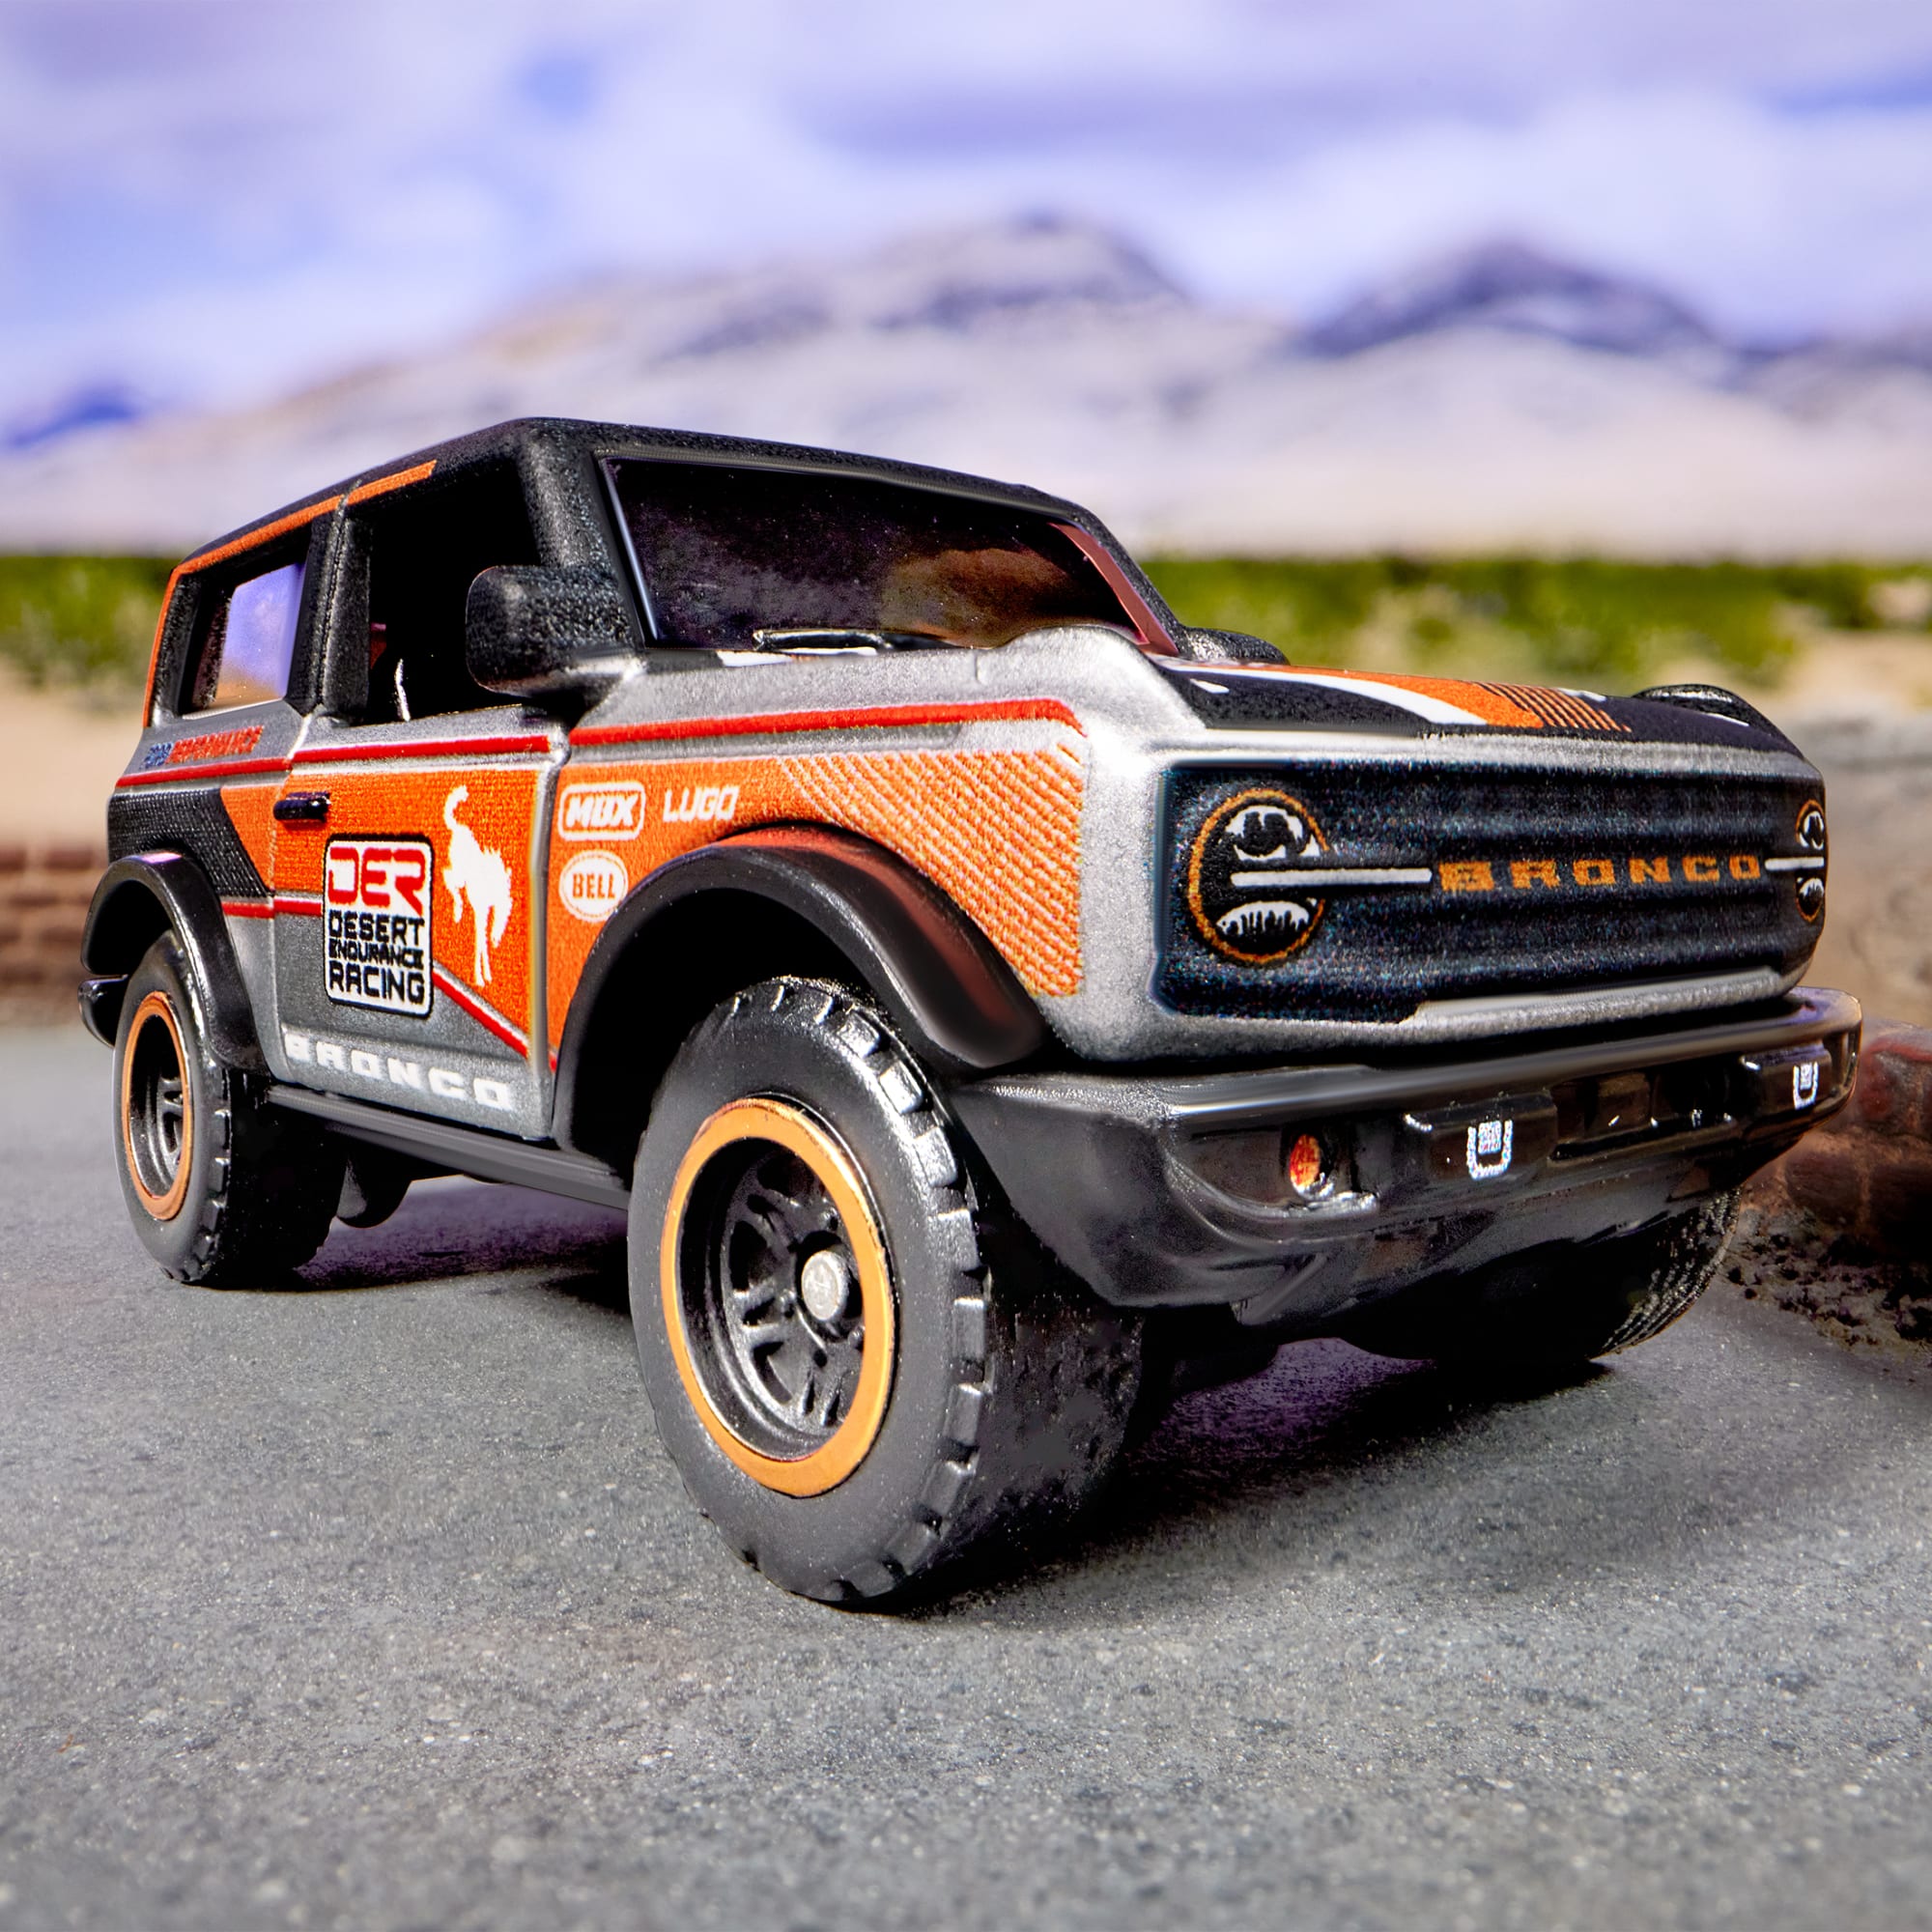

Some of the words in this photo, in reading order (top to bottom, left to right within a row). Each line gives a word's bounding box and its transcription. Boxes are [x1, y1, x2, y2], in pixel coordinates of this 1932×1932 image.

[663, 785, 741, 822] LUGO
[327, 847, 426, 916] DER
[572, 872, 615, 899] BELL
[1438, 856, 1761, 893] BRONCO
[328, 910, 425, 946] DESERT
[328, 938, 424, 970] ENDURANCE
[328, 960, 425, 1005] RACING
[284, 1033, 513, 1111] BRONCO
